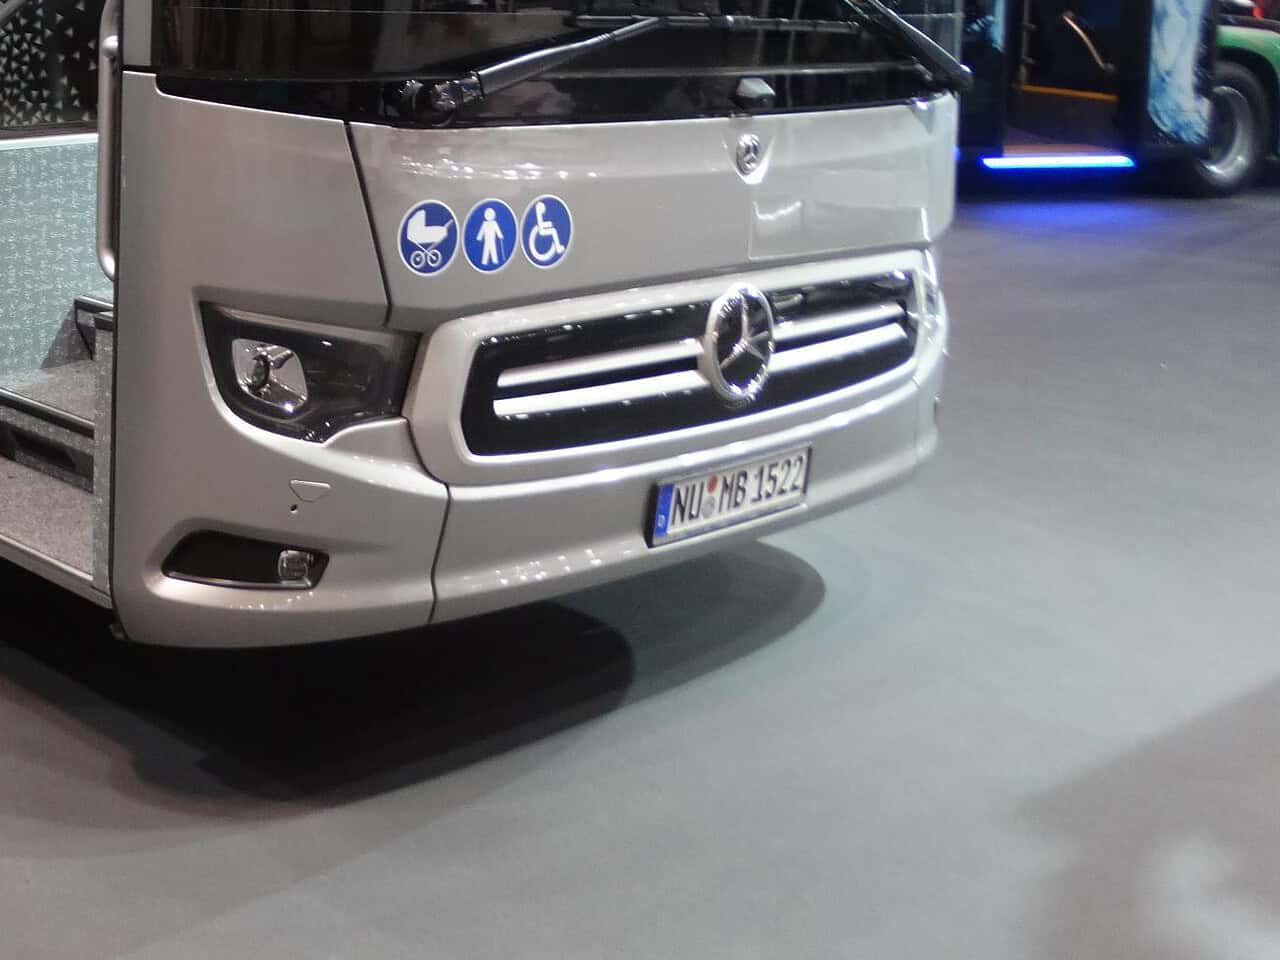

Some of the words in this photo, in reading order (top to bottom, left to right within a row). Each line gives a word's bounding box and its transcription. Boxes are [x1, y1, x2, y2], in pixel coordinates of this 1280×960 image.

[671, 481, 705, 526] NU
[718, 470, 749, 514] MB
[751, 454, 804, 504] 1522
